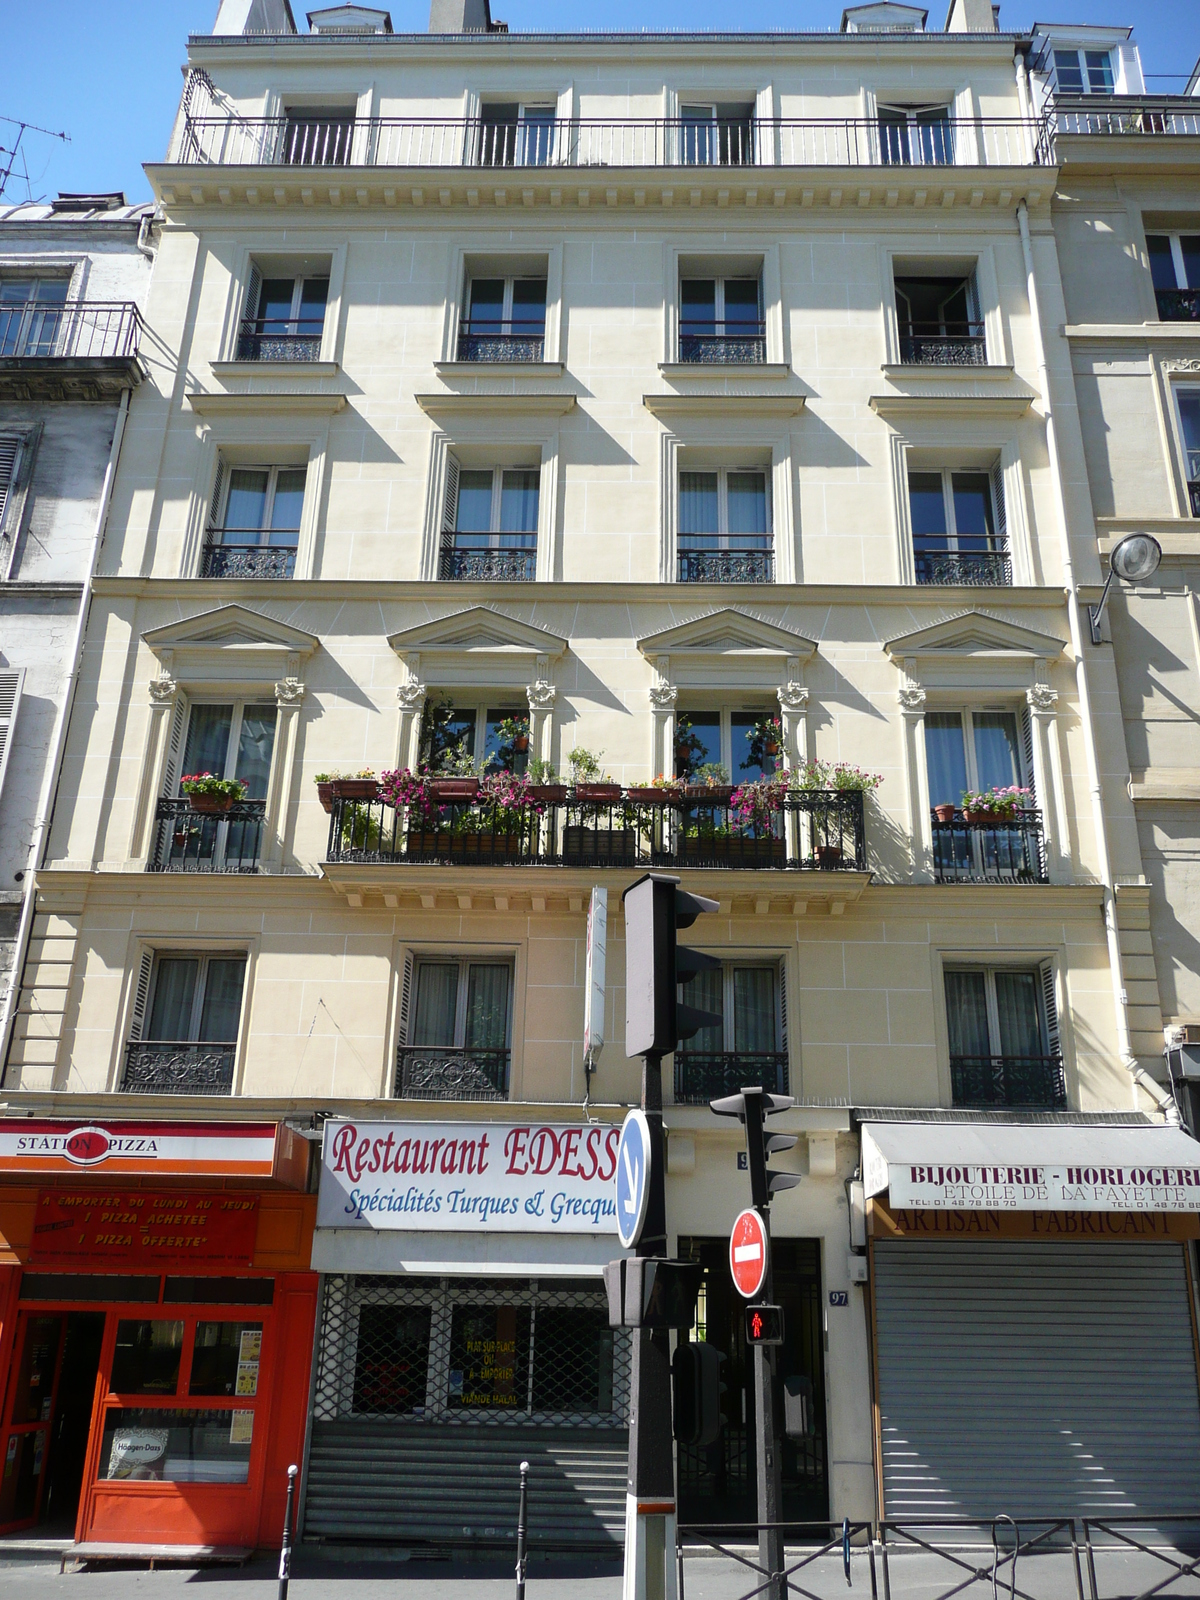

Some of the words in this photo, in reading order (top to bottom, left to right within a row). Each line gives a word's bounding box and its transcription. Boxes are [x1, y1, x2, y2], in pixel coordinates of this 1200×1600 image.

[17, 1137, 91, 1150] STATION
[107, 1139, 158, 1151] PIZZA
[332, 1124, 490, 1183] Restaurant
[504, 1127, 621, 1184] EDESS
[910, 1166, 1046, 1186] BIJOUTERIE
[1066, 1167, 1200, 1187] HORLOGERI
[944, 1185, 1016, 1199] ETOILE
[1093, 1187, 1187, 1202] FAYETTE
[43, 1197, 50, 1206] A
[58, 1197, 121, 1207] EMPORTER
[129, 1198, 145, 1207] DU
[153, 1199, 188, 1209] LUNDI
[196, 1200, 212, 1209] AU
[220, 1201, 255, 1210] JEUDI
[344, 1186, 442, 1220] Spécialités
[447, 1188, 519, 1222] Turques
[550, 1192, 616, 1224] Grecqu
[101, 1213, 138, 1223] PIZZA
[147, 1214, 208, 1225] ACHETEE
[95, 1235, 132, 1246] PIZZA
[832, 1293, 846, 1304] 97
